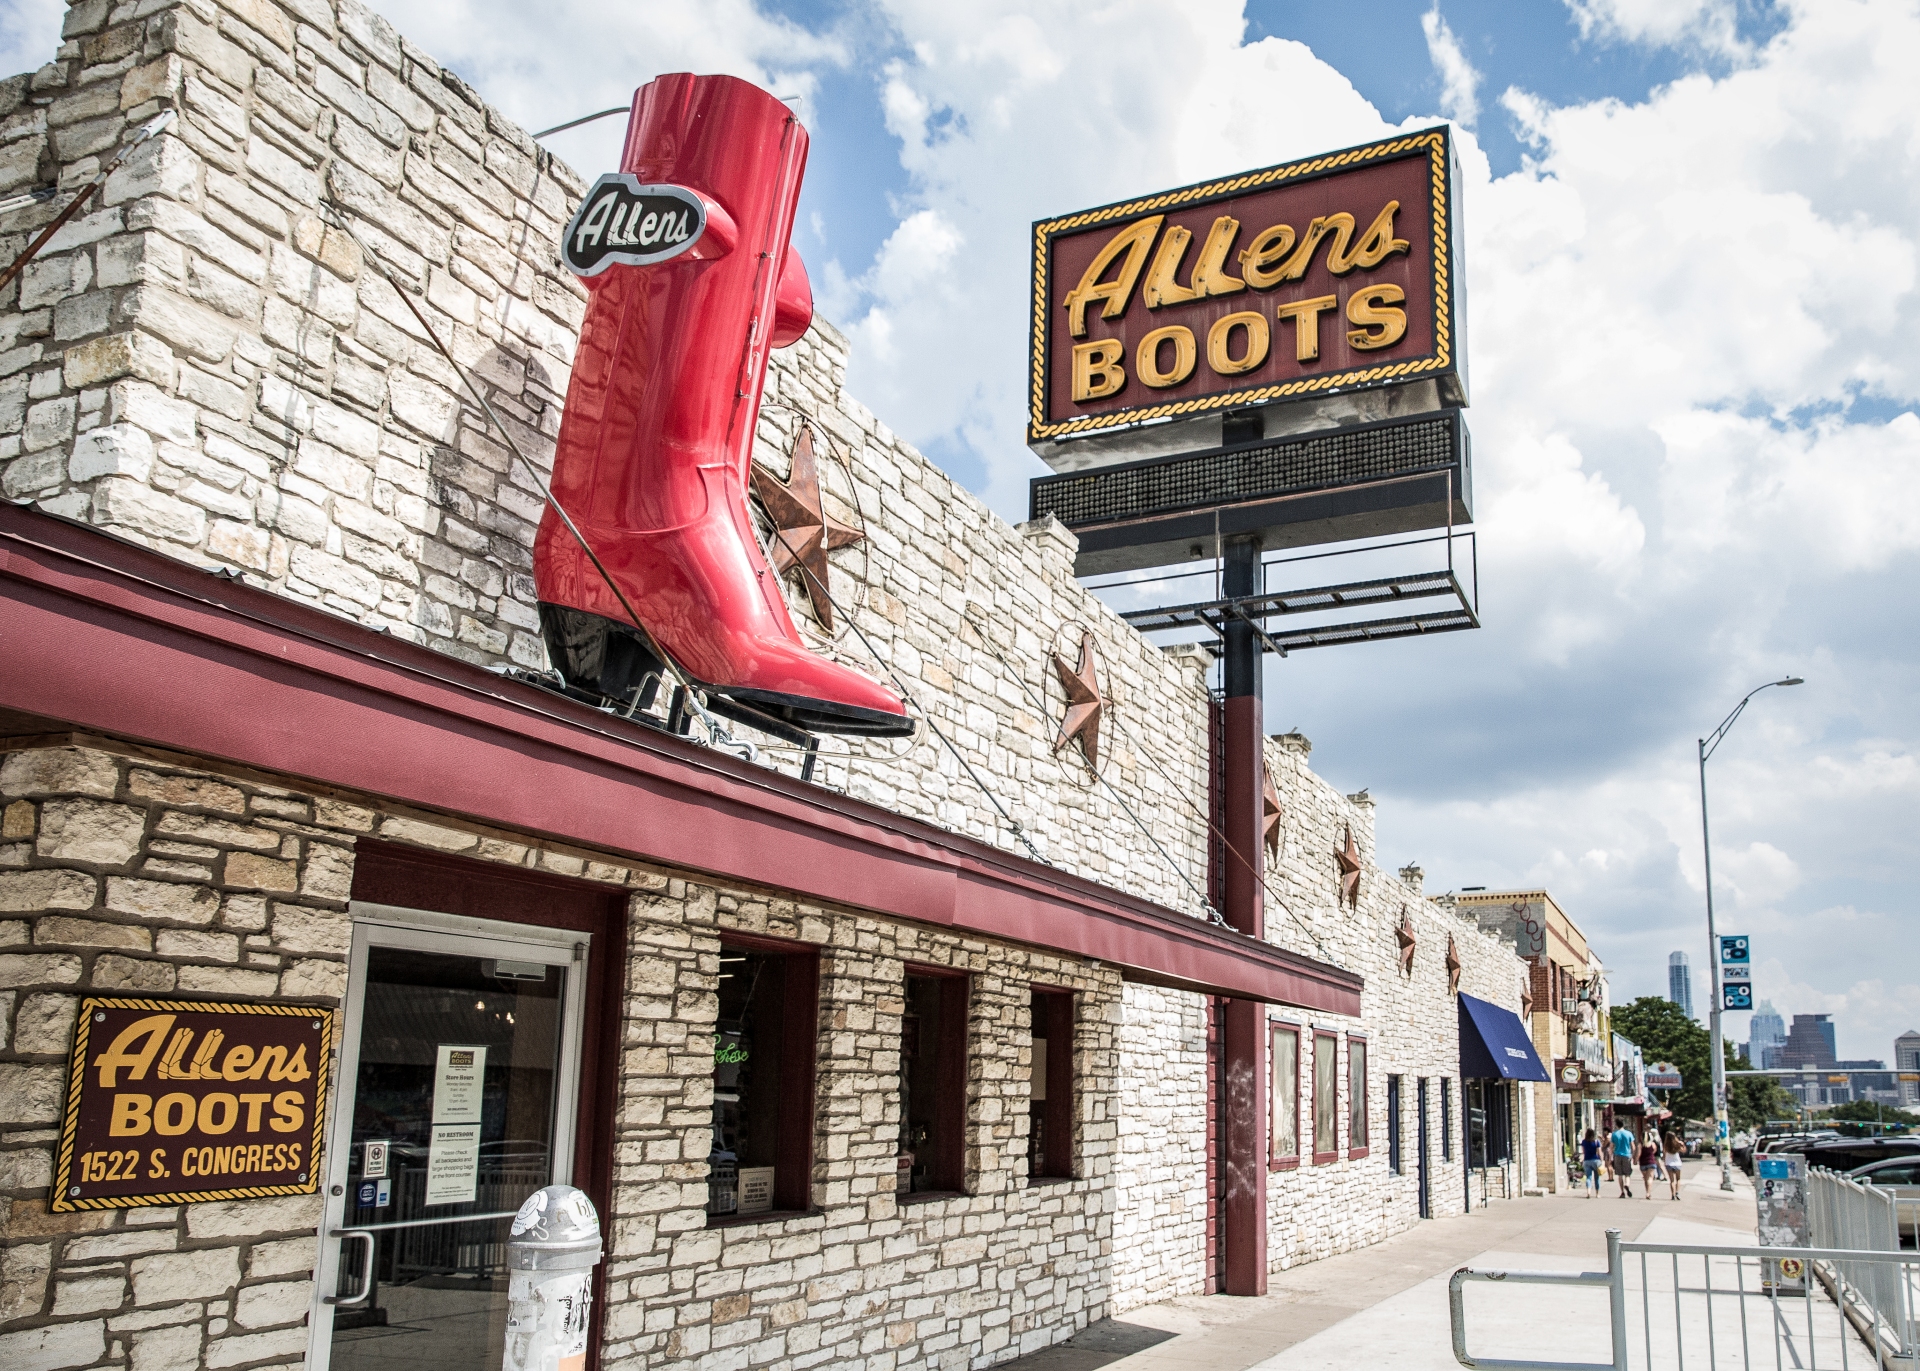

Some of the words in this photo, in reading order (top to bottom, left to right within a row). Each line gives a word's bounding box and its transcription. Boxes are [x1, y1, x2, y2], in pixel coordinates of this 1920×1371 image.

[576, 191, 689, 253] Allens
[1063, 200, 1410, 337] Allens
[1071, 283, 1407, 402] BOOTS
[93, 1014, 312, 1088] Allens
[108, 1091, 305, 1137] BOOTS
[80, 1150, 139, 1182] 1522
[148, 1148, 171, 1178] S.
[181, 1143, 302, 1176] CONGRESS
